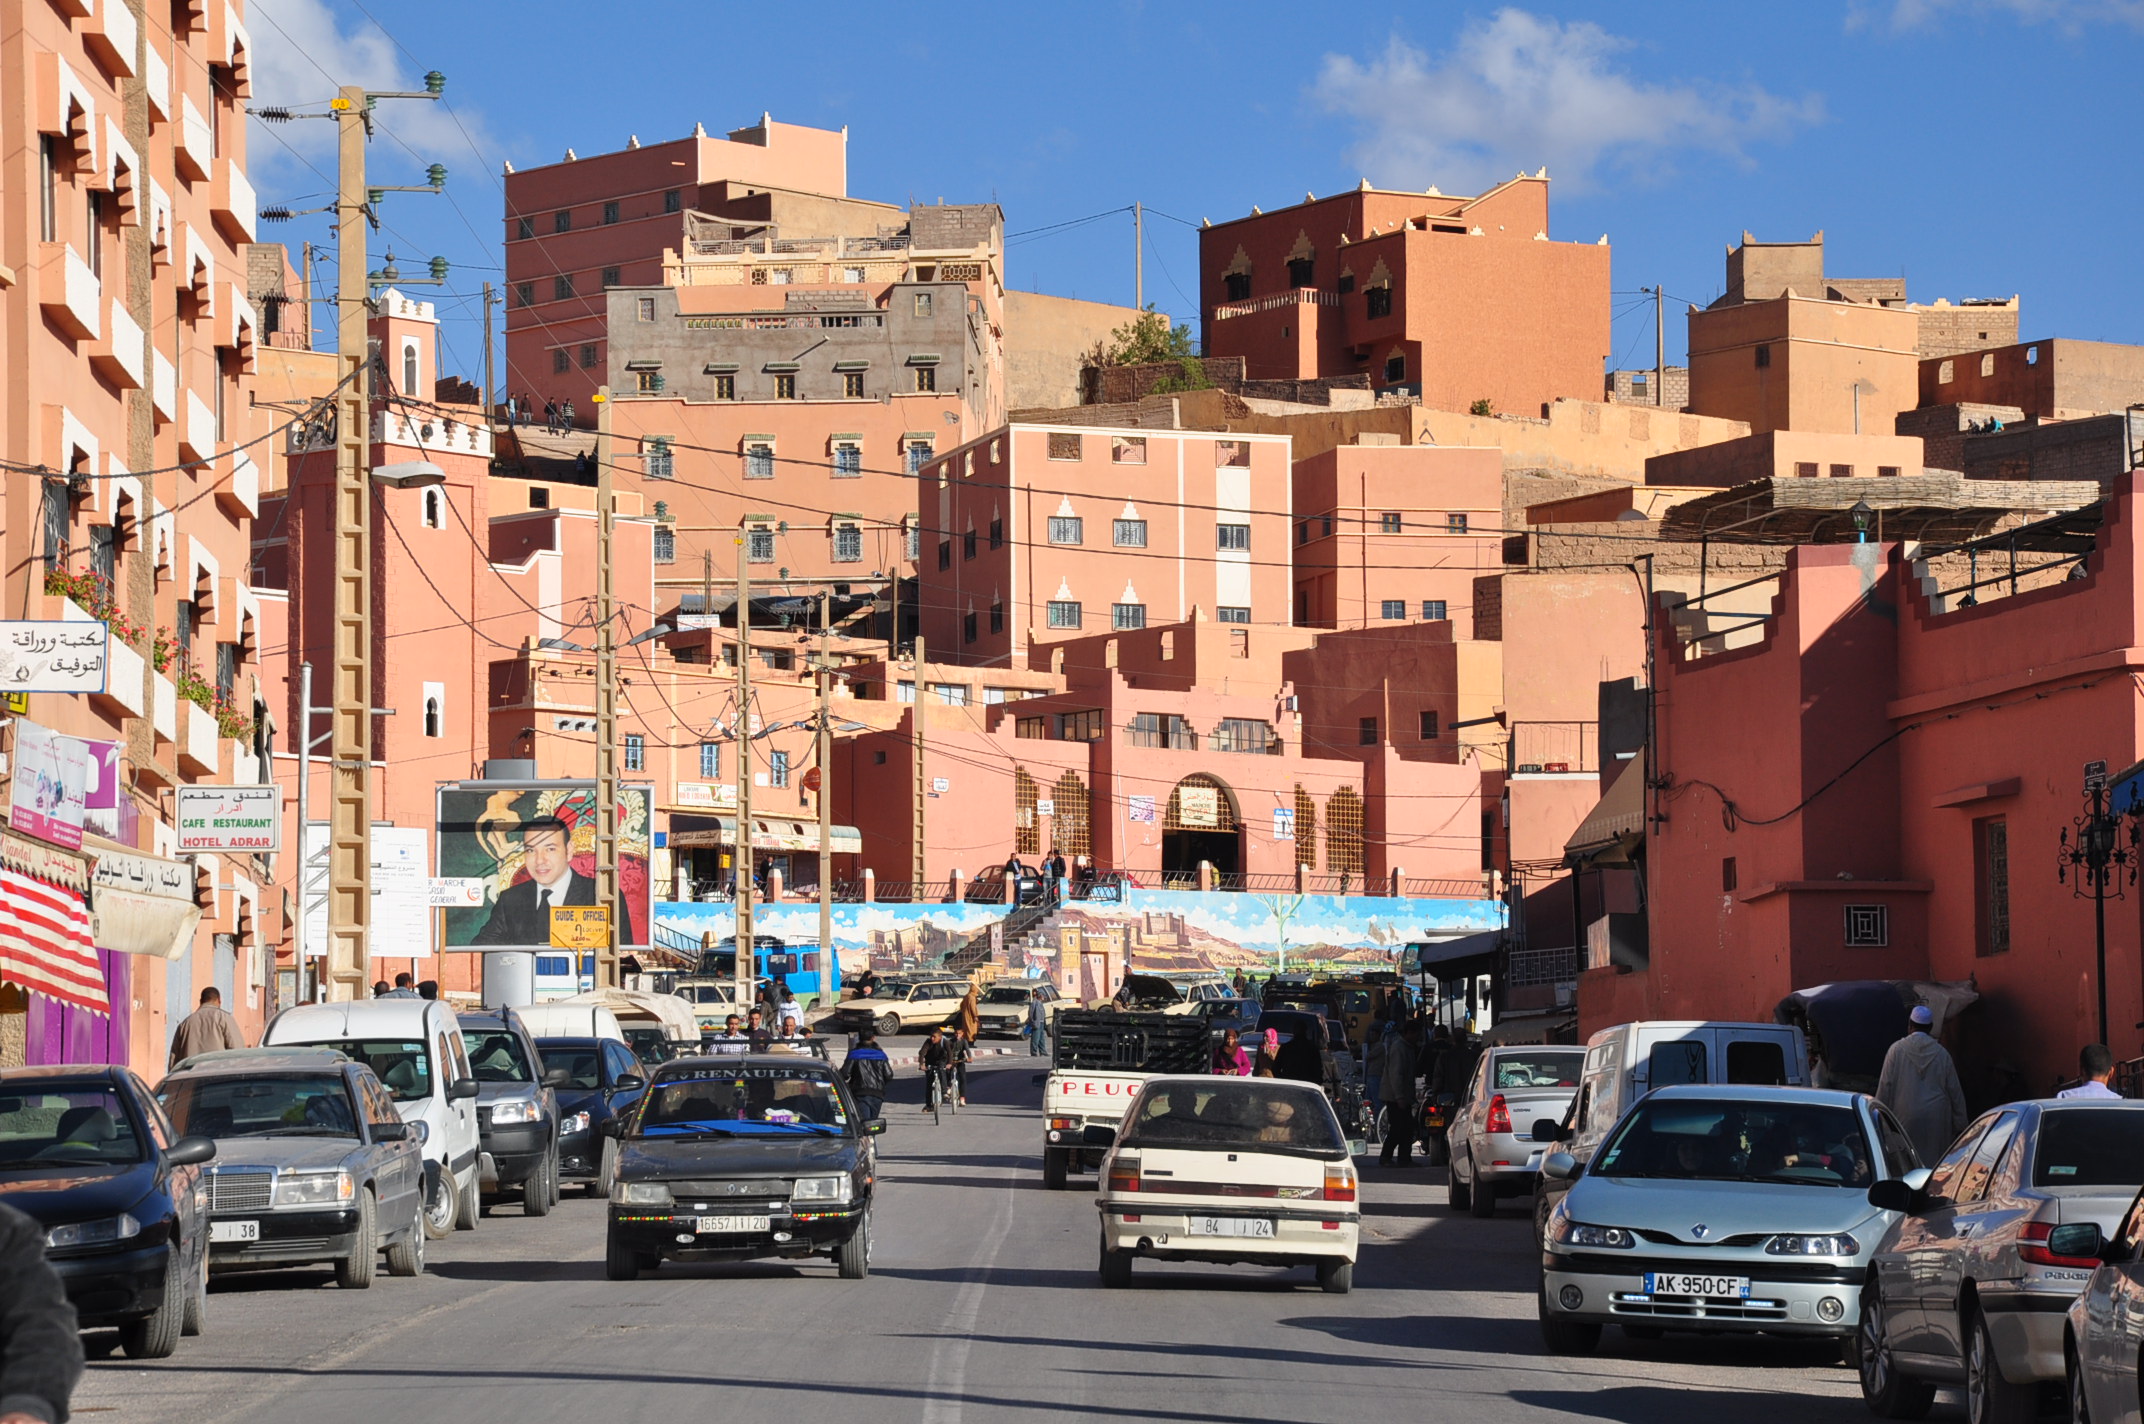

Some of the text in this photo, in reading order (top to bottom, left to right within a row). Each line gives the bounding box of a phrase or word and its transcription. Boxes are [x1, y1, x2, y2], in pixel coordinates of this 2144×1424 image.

[60, 631, 104, 648] مكتبة
[50, 655, 103, 677] التوفيق
[182, 791, 272, 803] فندق مطعم
[182, 819, 272, 828] CAFE RESTAURANT
[183, 838, 270, 847] HOTEL ADRAR
[430, 896, 457, 904] GENERAL
[694, 1069, 793, 1079] RENAULT
[753, 1217, 766, 1229] 20
[1205, 1223, 1218, 1233] 84
[1255, 1223, 1269, 1235] 24
[241, 1224, 256, 1238] 38
